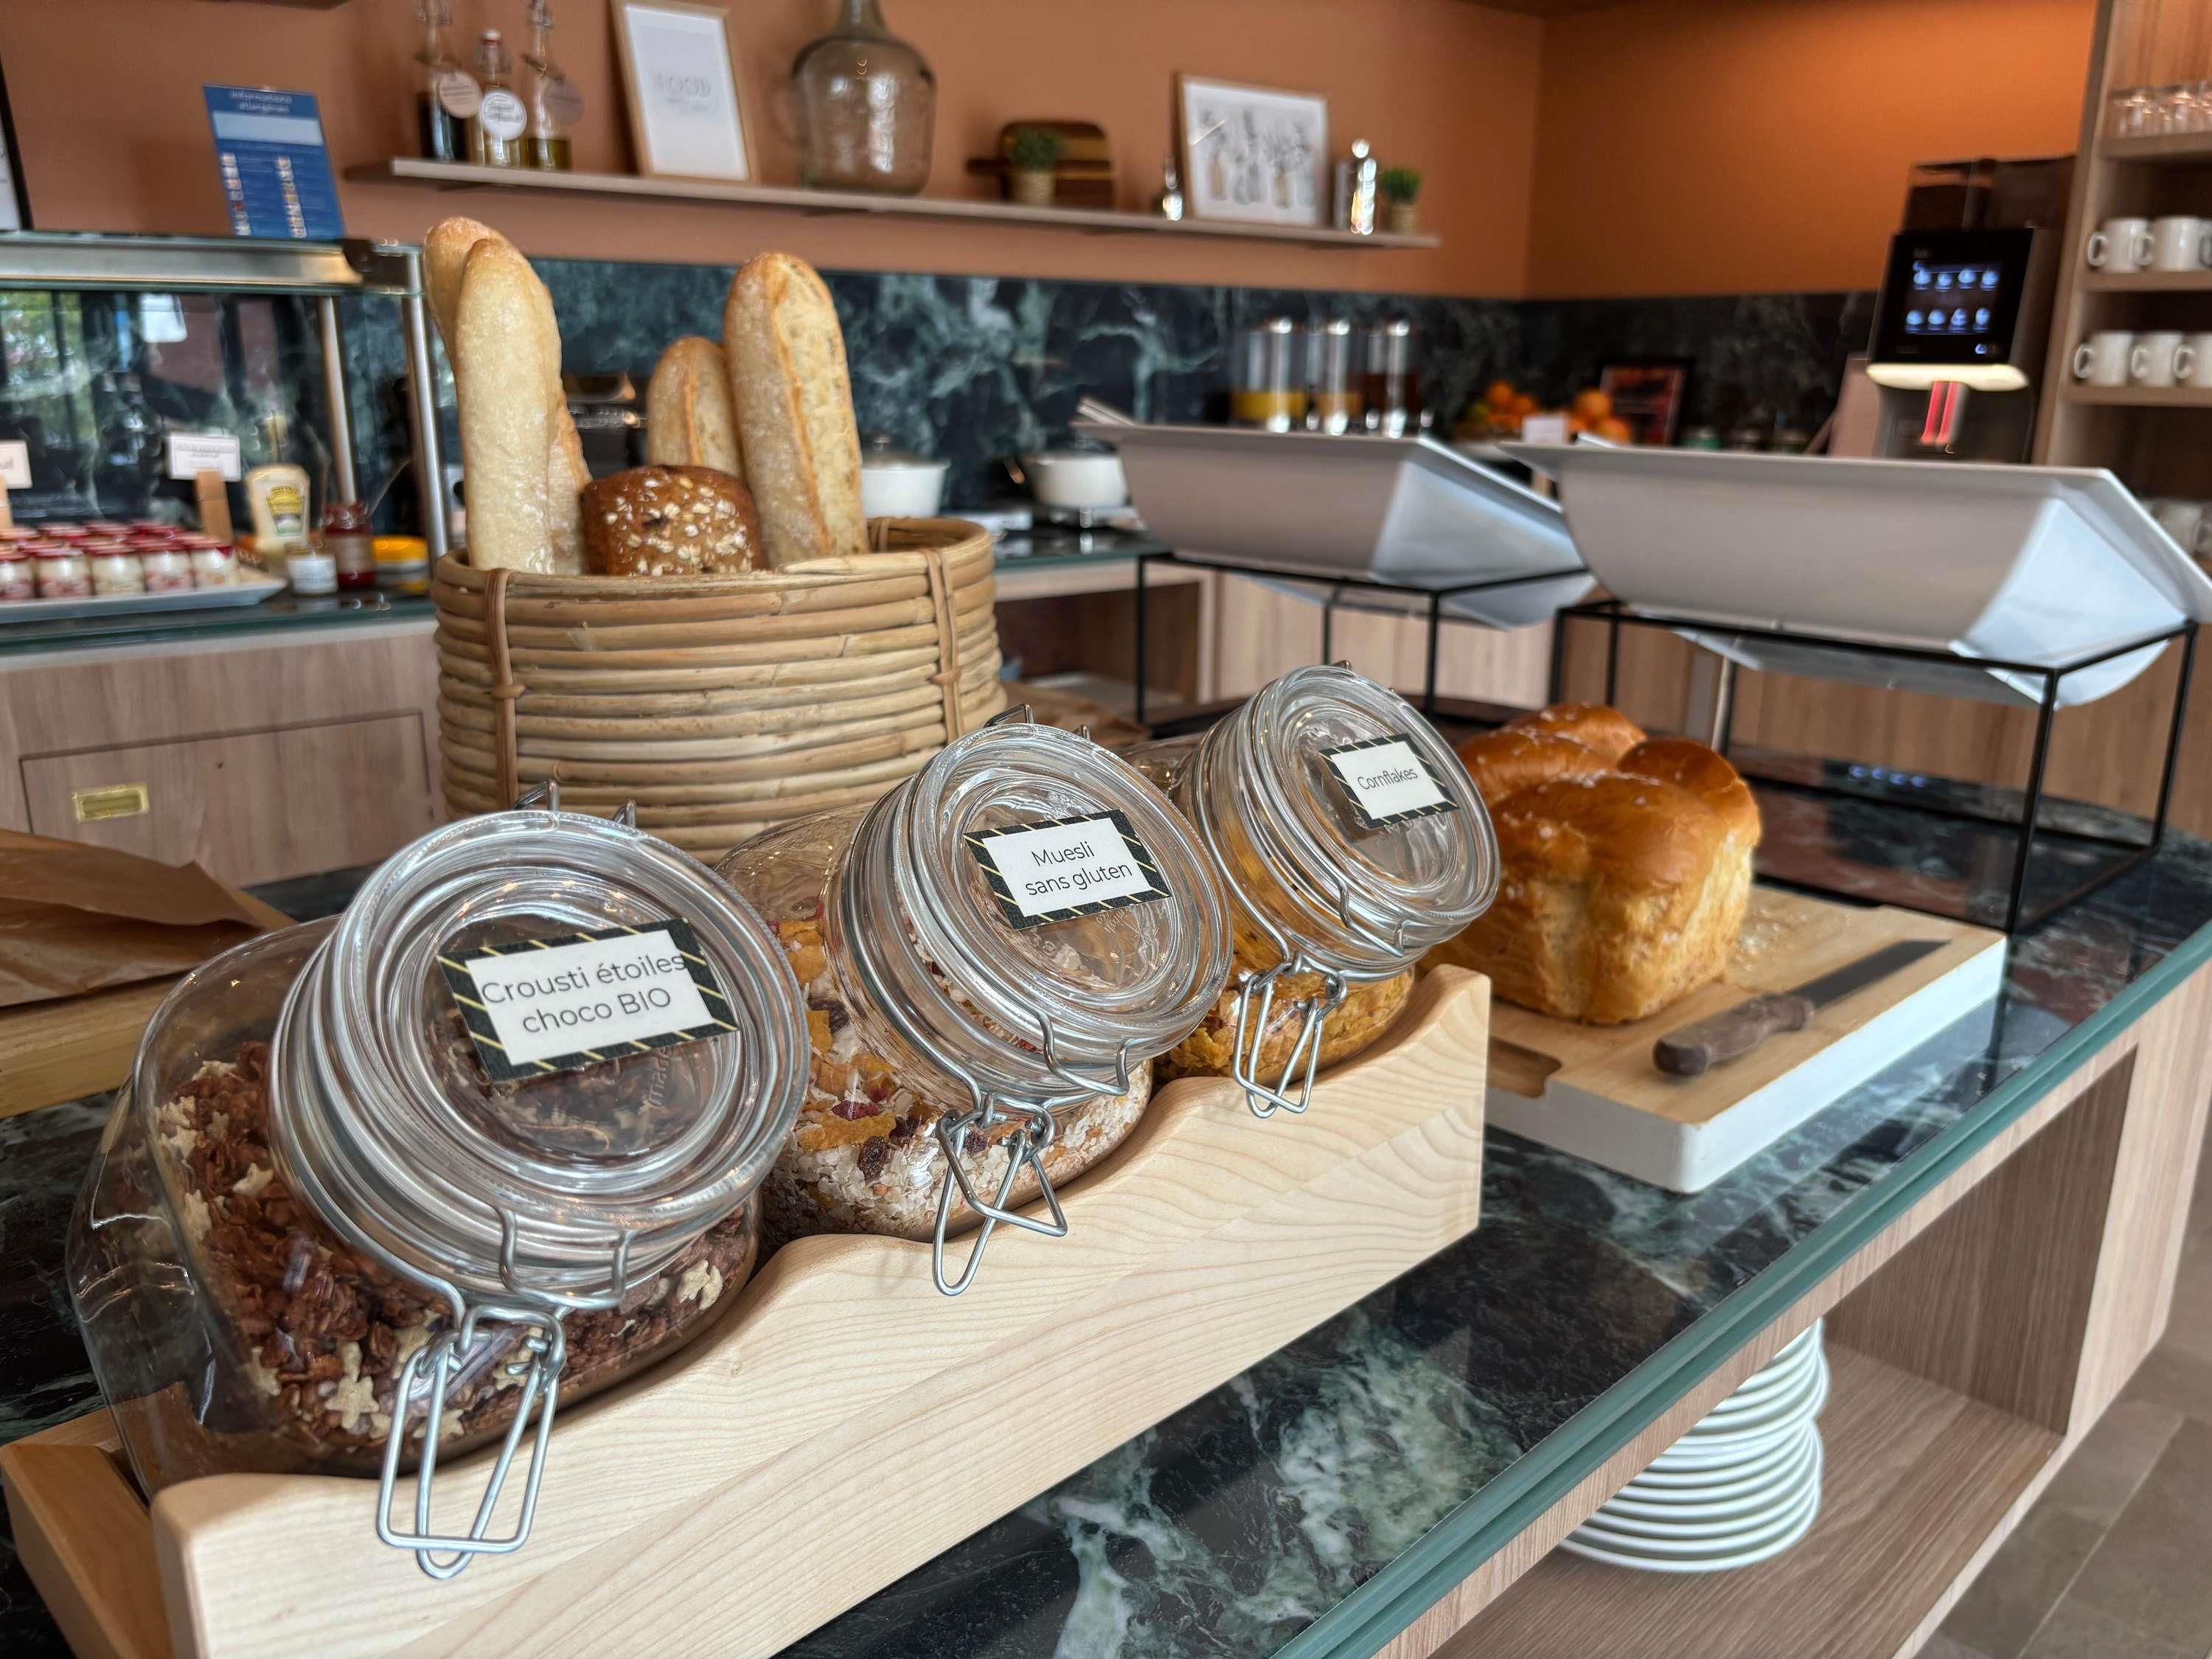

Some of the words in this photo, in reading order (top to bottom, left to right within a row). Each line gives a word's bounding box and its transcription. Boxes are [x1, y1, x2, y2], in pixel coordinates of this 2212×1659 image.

[1357, 768, 1419, 790] Cornflakes
[1031, 841, 1096, 867] Muesli
[1025, 874, 1071, 896] sans
[1071, 863, 1133, 890] gluten
[481, 966, 590, 1004] Crousti
[596, 953, 686, 984] étoiles
[522, 1001, 613, 1033] choco
[617, 987, 672, 1015] BIO
